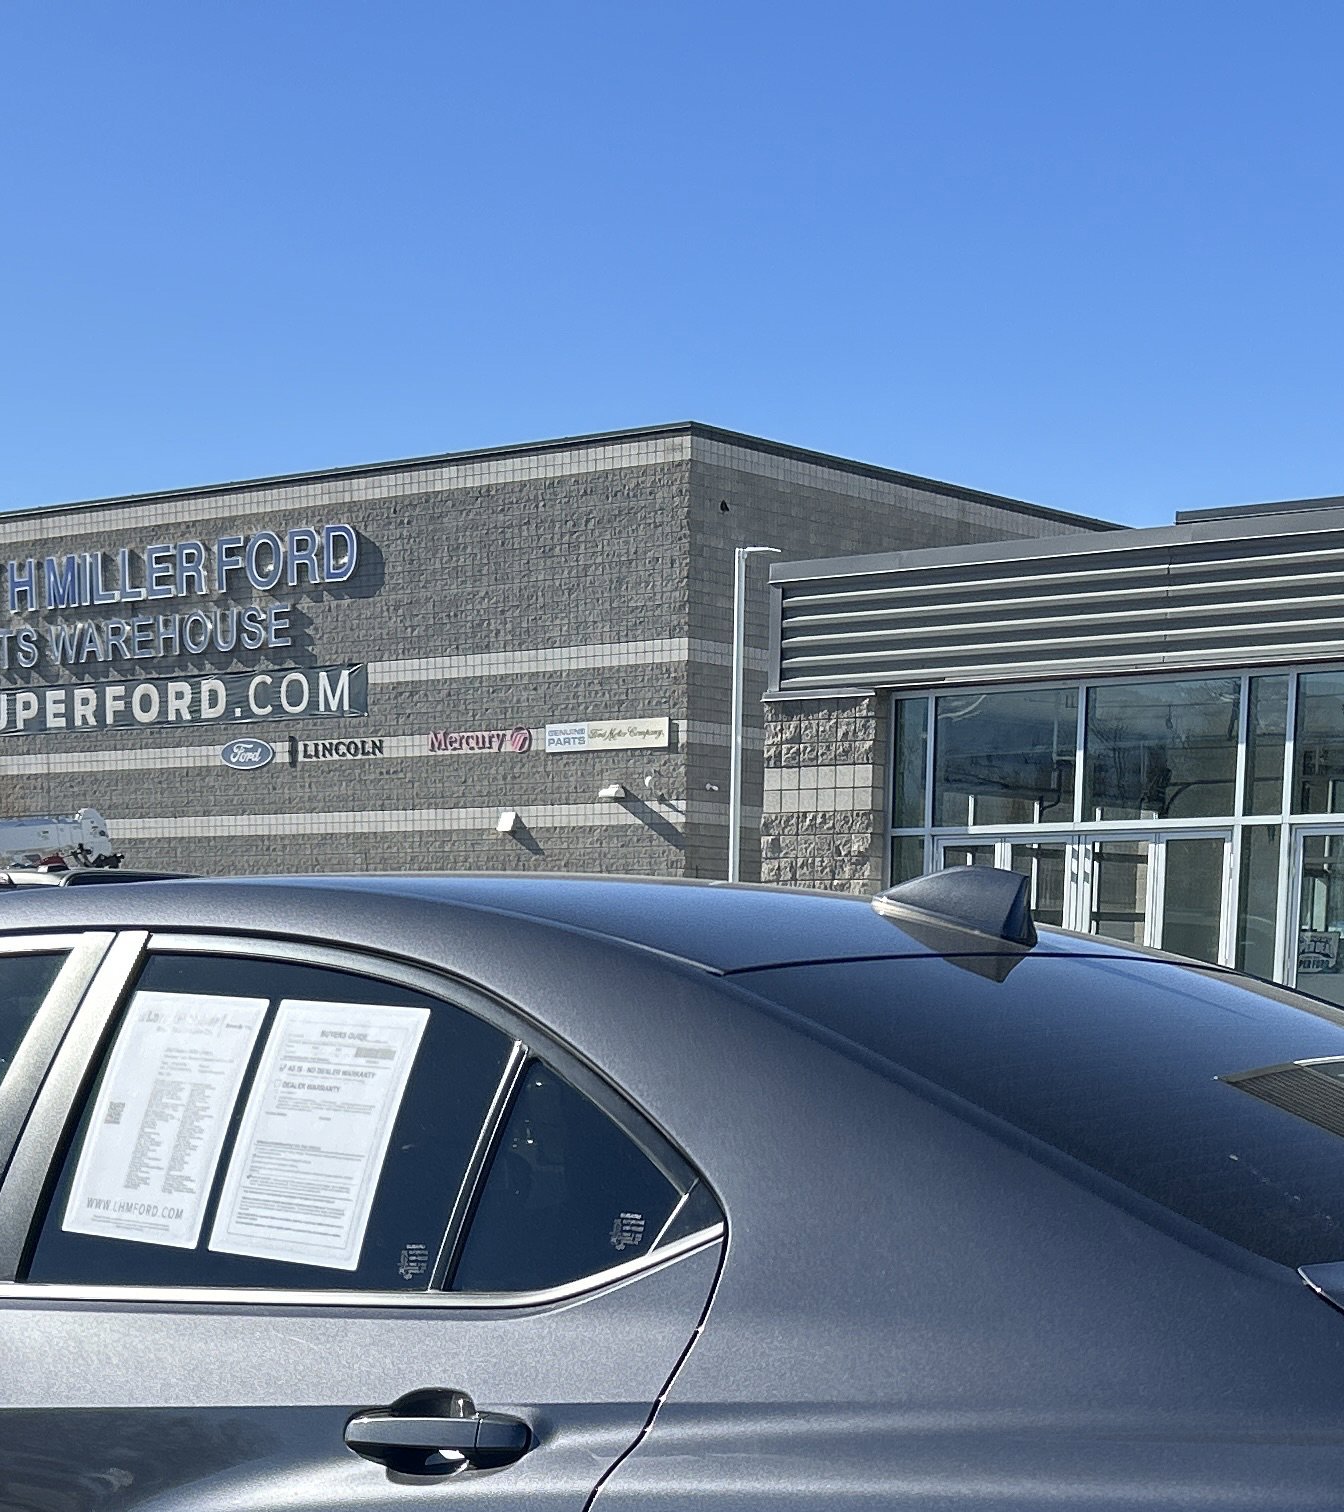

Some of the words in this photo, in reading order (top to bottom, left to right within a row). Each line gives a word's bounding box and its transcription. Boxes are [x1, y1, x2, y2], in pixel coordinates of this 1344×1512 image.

[8, 558, 36, 613] H
[45, 540, 207, 610] MILLER
[216, 523, 357, 593] FORD
[50, 604, 292, 664] WAREHOUSE
[302, 739, 385, 759] LINCOLN
[429, 729, 506, 753] Mercury
[547, 736, 586, 746] PARTS
